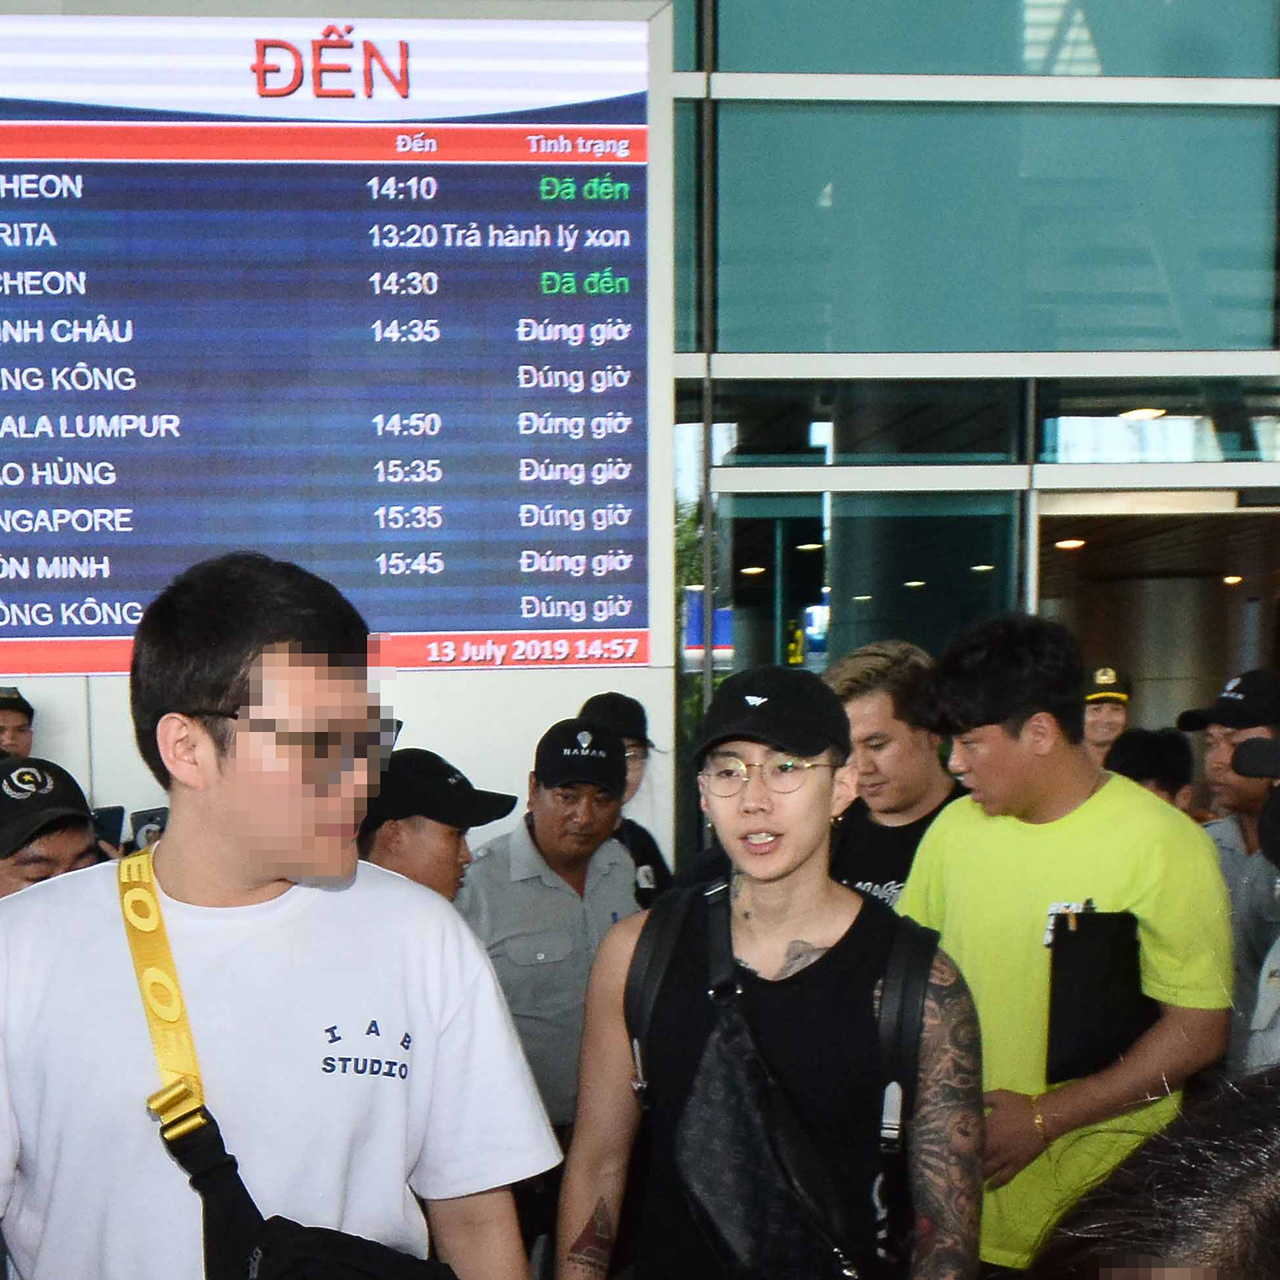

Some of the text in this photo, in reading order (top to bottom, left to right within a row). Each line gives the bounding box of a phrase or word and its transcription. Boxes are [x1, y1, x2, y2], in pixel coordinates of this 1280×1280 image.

[251, 25, 409, 98] ĐẾN
[396, 132, 437, 153] Đến
[367, 177, 437, 200] 14:10
[540, 174, 629, 200] Đã đến
[368, 224, 438, 248] 13:20
[443, 224, 630, 253] Trả hành lý xon
[369, 272, 438, 296] 14:30
[541, 269, 629, 295] Đã đến
[51, 314, 133, 343] CHÂU
[371, 320, 439, 343] 14:35
[516, 316, 630, 347] Đúng giờ
[52, 362, 136, 391] KÔNG
[518, 363, 630, 393] Đúng giờ
[61, 415, 180, 438] LUMPUR
[372, 413, 441, 437] 14:50
[518, 410, 631, 440] Đúng giờ
[31, 456, 116, 486] HÙNG
[374, 460, 442, 483] 15:35
[519, 457, 631, 486] Đúng giờ
[375, 506, 442, 530] 15:35
[519, 503, 631, 532] Đúng giờ
[36, 557, 109, 580] MINH
[376, 553, 444, 576] 15:45
[520, 549, 631, 578] Đúng giờ
[61, 598, 144, 625] KÔNG
[521, 594, 631, 624] Đúng giờ
[427, 639, 639, 666] 13 July 2019 14:57
[321, 1056, 408, 1080] STUDIO
